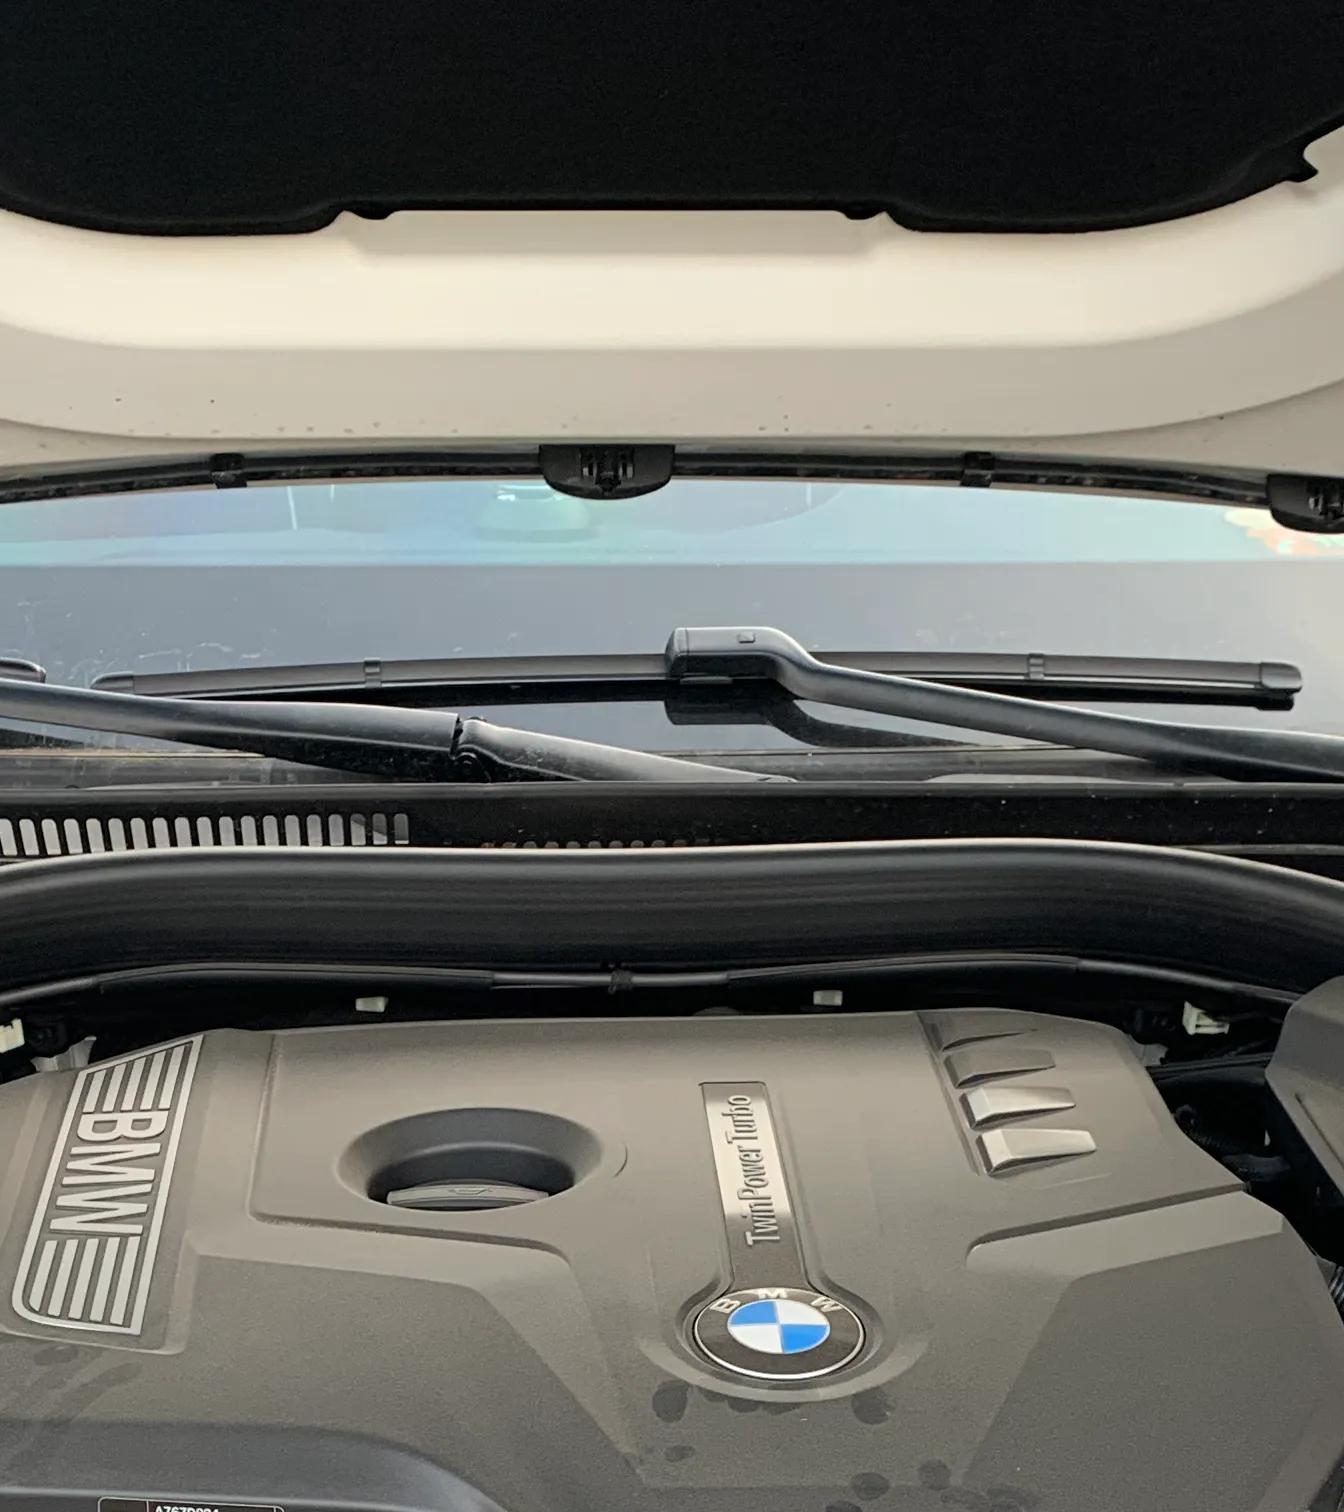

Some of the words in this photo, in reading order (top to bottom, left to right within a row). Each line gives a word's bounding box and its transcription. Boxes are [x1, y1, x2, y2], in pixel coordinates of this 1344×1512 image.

[722, 1094, 759, 1144] Turbo
[49, 1110, 169, 1235] BMW
[737, 1145, 781, 1246] TwinPower
[709, 1287, 843, 1314] BMW
